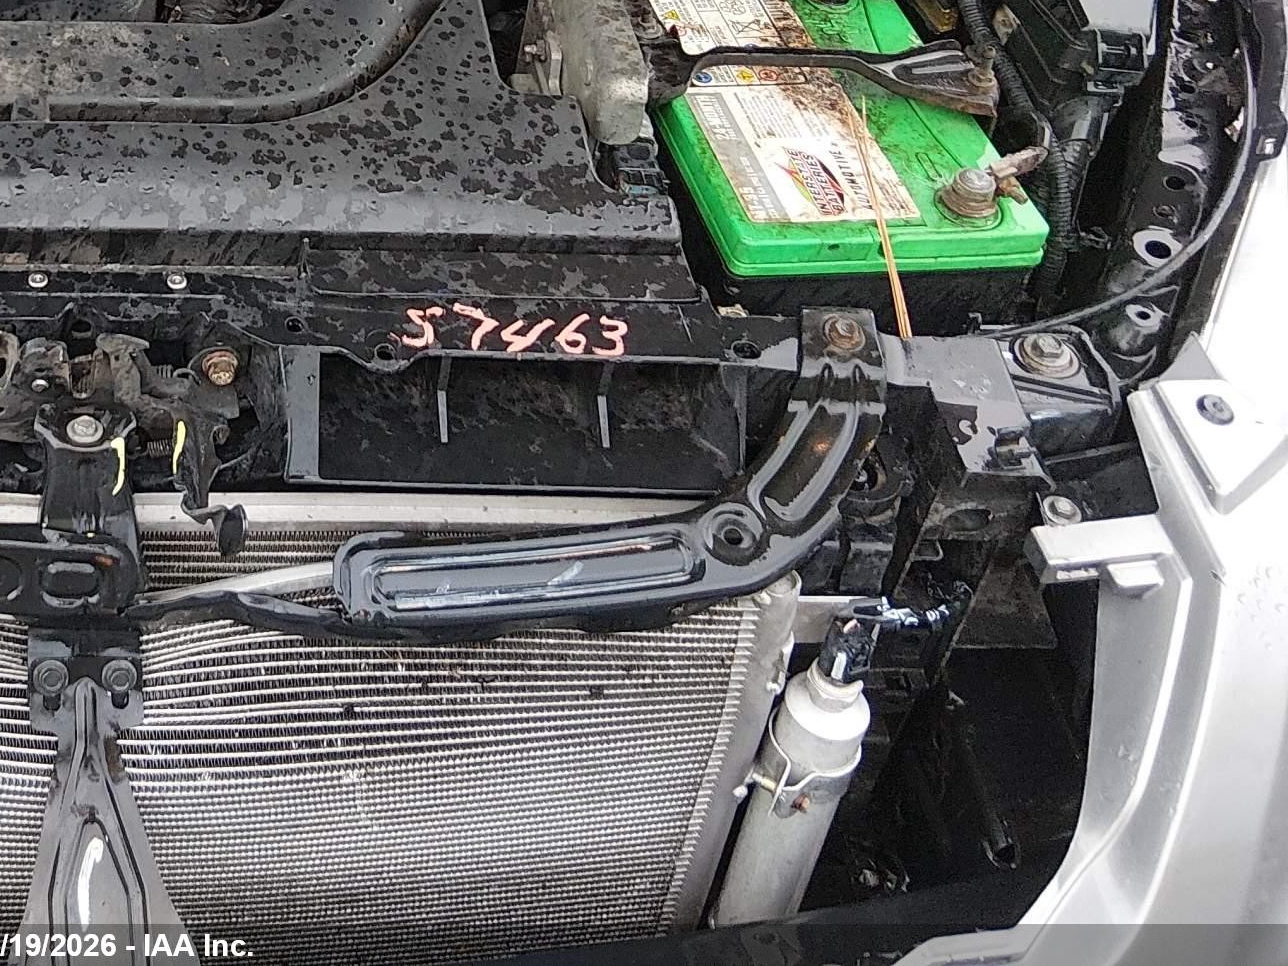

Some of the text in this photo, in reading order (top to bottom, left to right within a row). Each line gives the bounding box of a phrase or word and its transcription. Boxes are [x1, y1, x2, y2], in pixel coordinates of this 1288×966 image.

[786, 149, 833, 216] INTERSTATE
[801, 153, 845, 213] BATTERIES
[827, 149, 875, 211] AUTOMOTIVE
[401, 302, 628, 356] 57463
